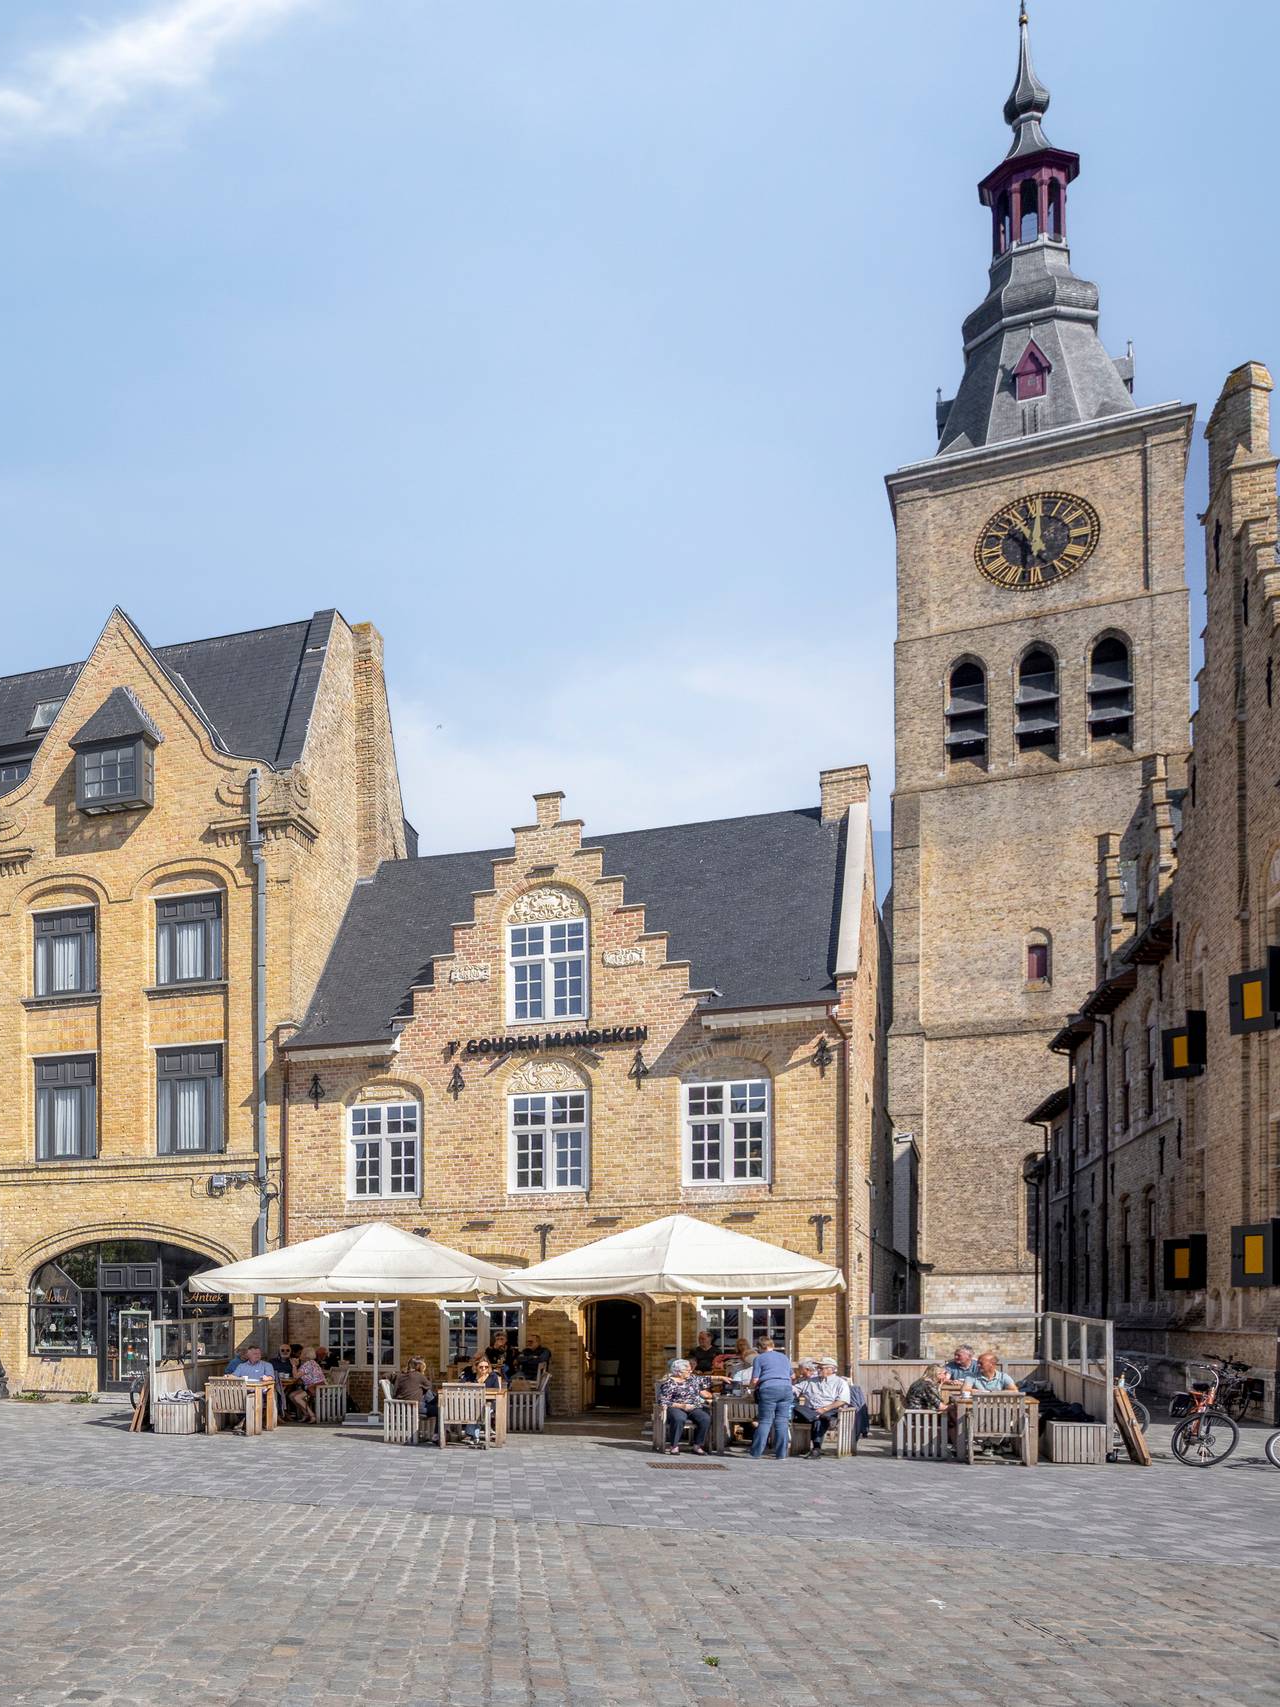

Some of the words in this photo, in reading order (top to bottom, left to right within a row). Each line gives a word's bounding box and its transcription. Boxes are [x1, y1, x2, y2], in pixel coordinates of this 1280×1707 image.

[466, 1035, 540, 1054] GOUDEN
[546, 1025, 648, 1047] MANDEKEN
[187, 1291, 224, 1302] Antiek
